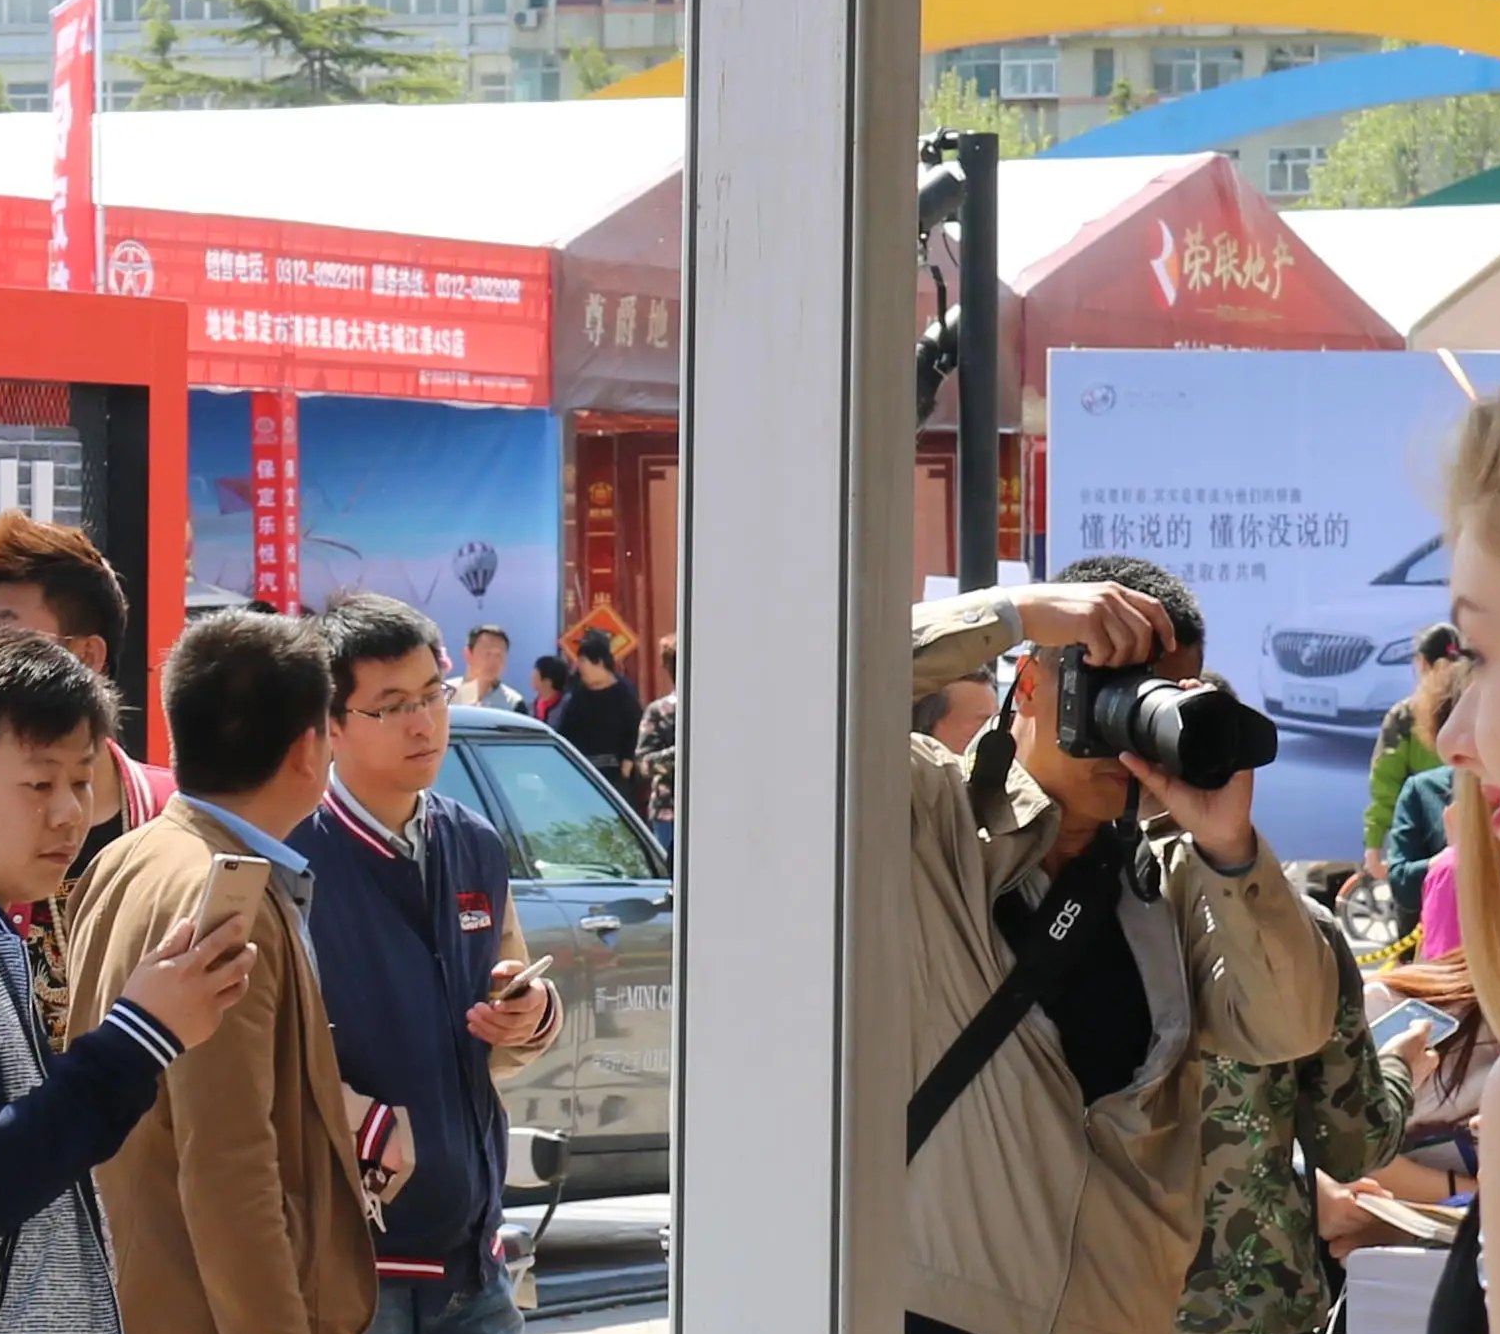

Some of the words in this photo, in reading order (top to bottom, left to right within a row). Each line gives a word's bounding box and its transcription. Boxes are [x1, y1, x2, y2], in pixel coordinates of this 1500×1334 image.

[1183, 220, 1295, 300] 荣联地产
[582, 292, 669, 348] 尊爵地
[1080, 514, 1191, 550] 懂你说的
[1209, 513, 1349, 549] 懂你没说的
[1048, 899, 1082, 942] EOS
